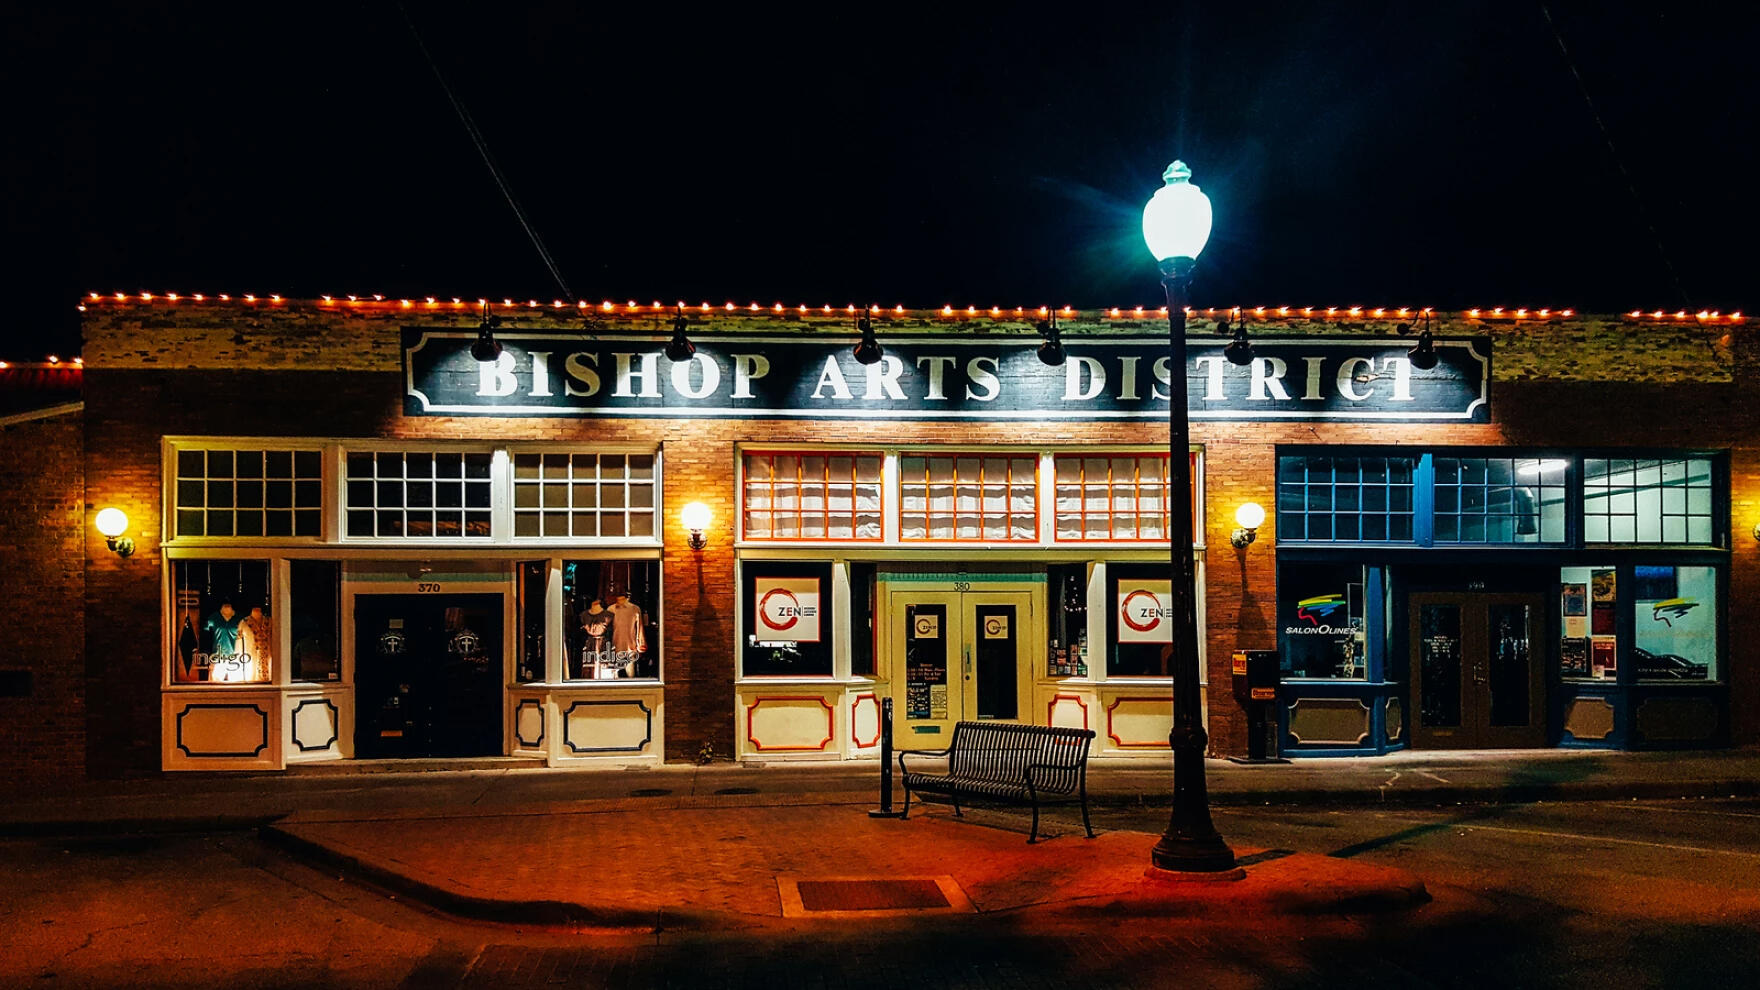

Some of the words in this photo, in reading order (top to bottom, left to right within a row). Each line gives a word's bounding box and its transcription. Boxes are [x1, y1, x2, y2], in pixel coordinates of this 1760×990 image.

[475, 350, 771, 399] BISHOP
[810, 354, 1001, 401] ARTS
[418, 583, 441, 593] 370
[954, 582, 970, 592] 380
[778, 607, 802, 617] ZEN
[1140, 608, 1164, 618] ZEN
[192, 643, 252, 672] indigo
[582, 641, 640, 670] indigo
